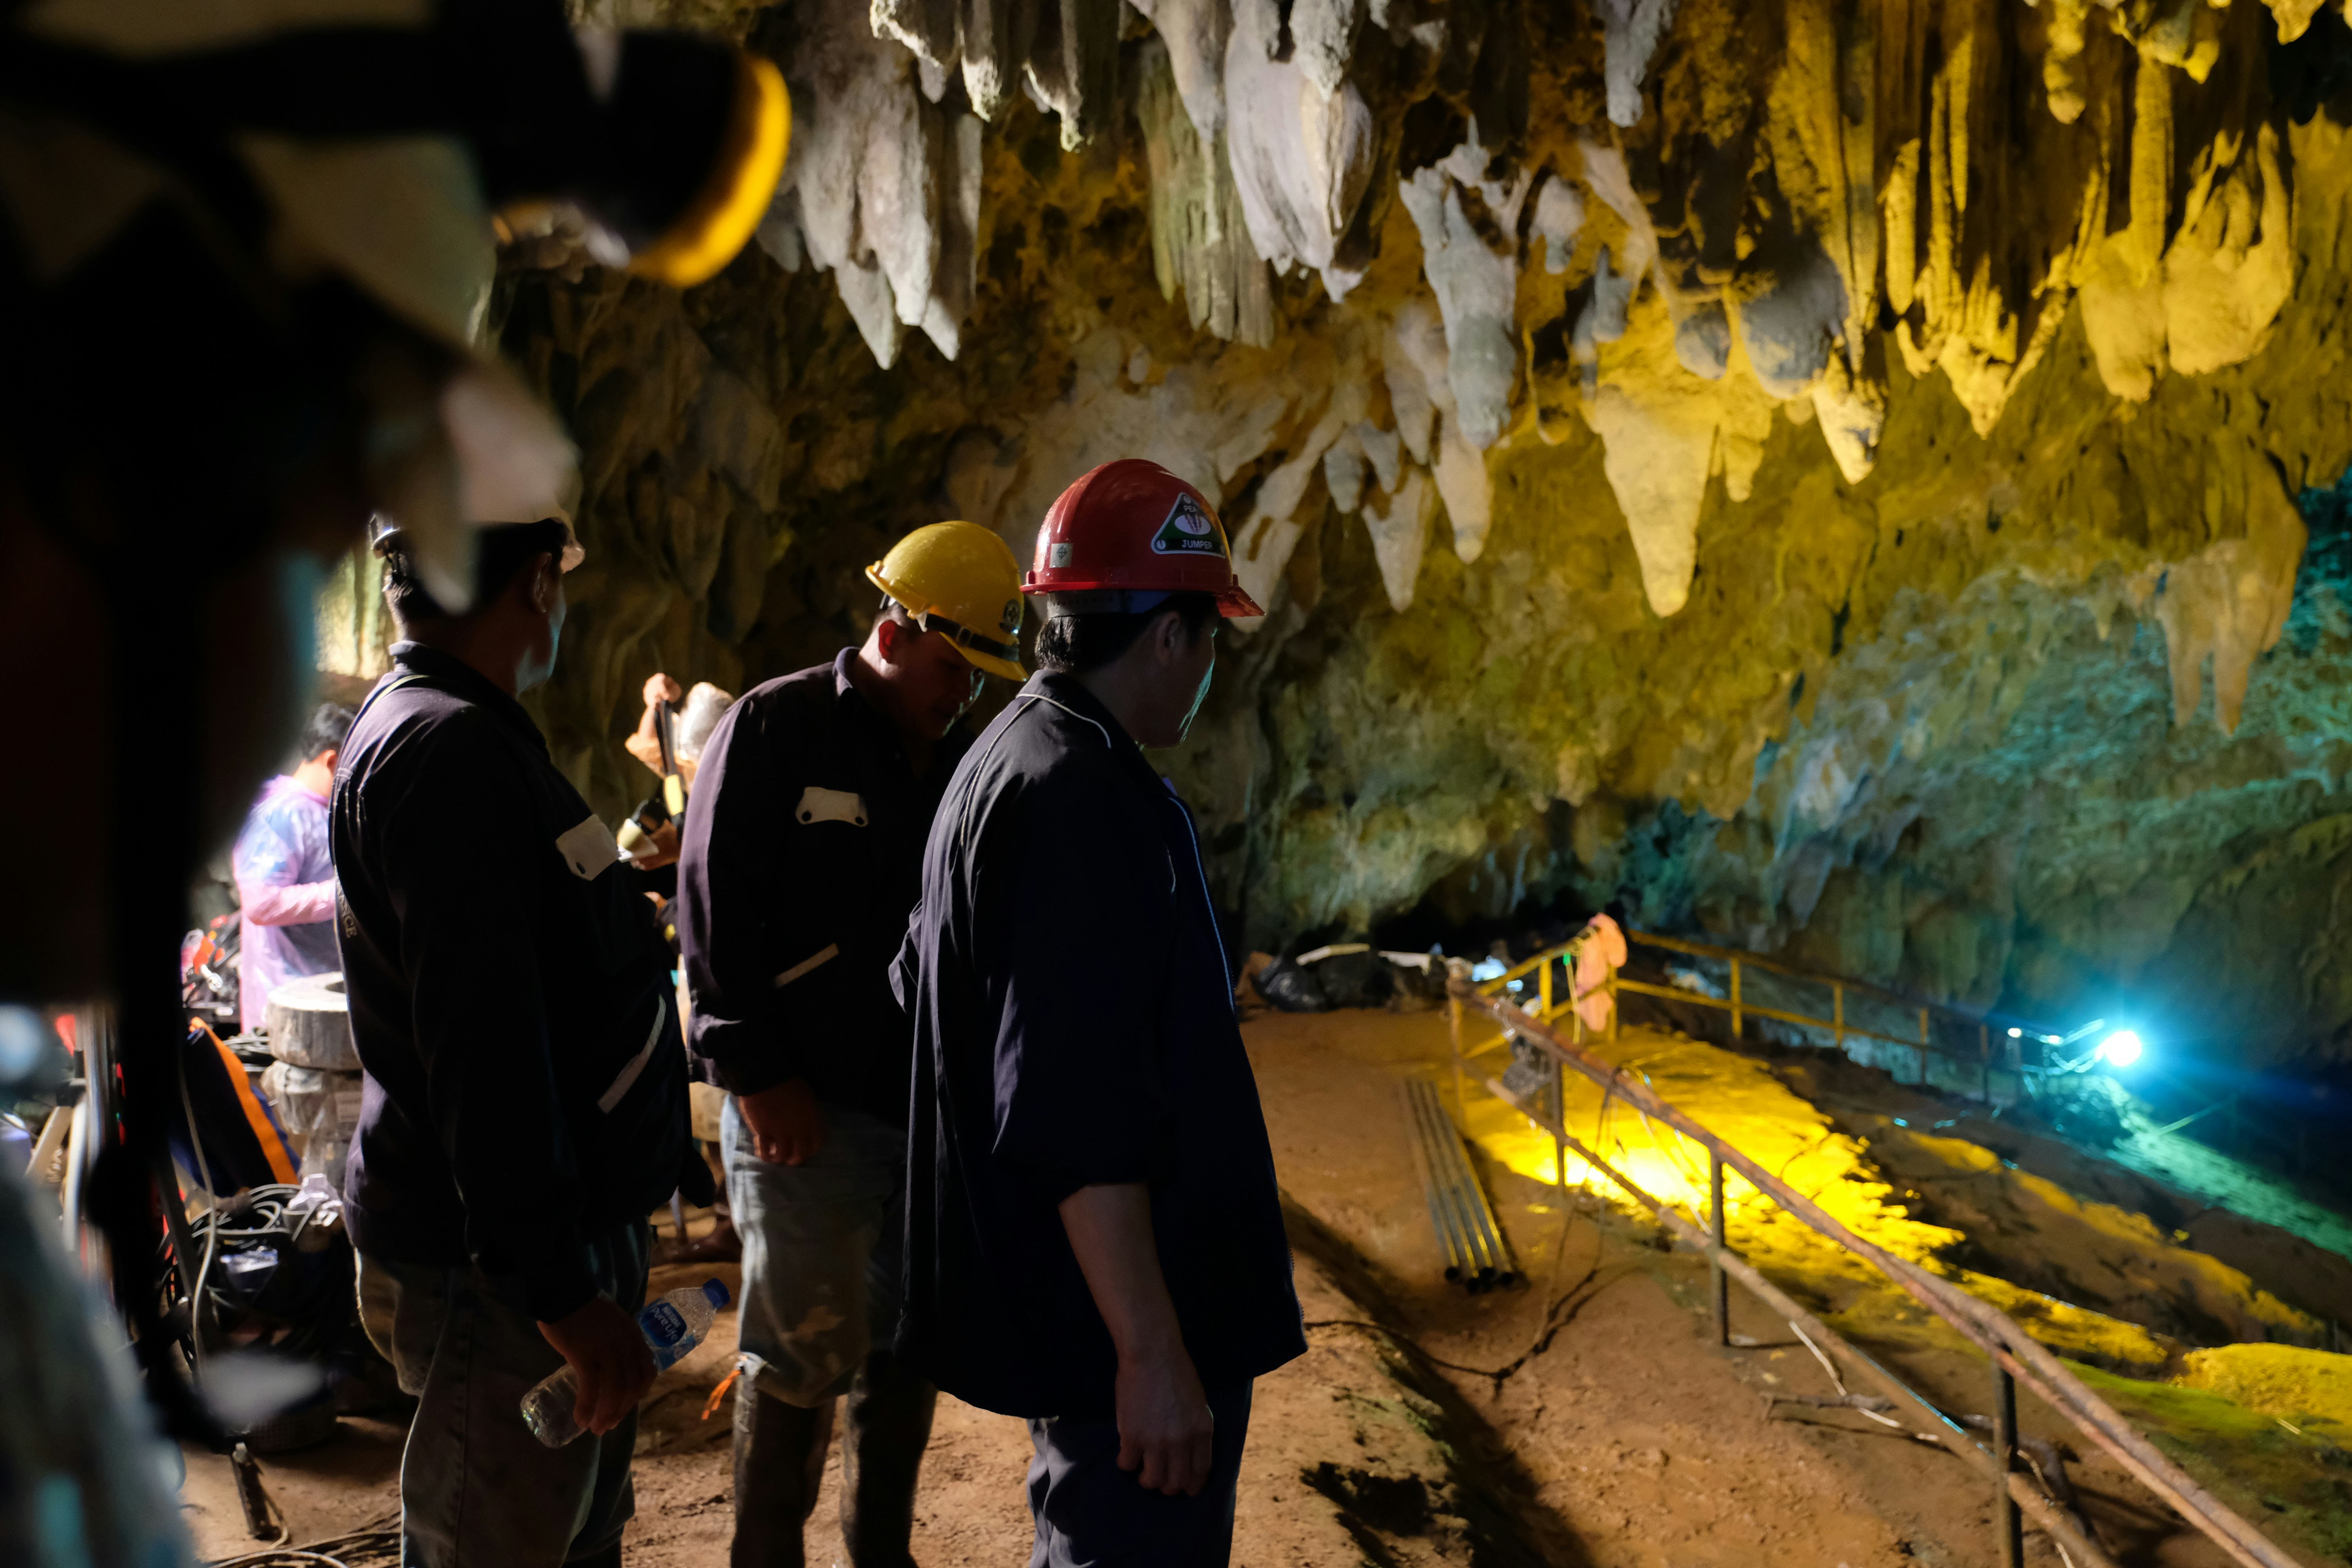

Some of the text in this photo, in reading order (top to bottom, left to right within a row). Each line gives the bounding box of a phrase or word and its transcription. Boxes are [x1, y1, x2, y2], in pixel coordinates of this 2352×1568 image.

[1182, 539, 1213, 550] JUMPER
[650, 1307, 678, 1341] Pure Life
